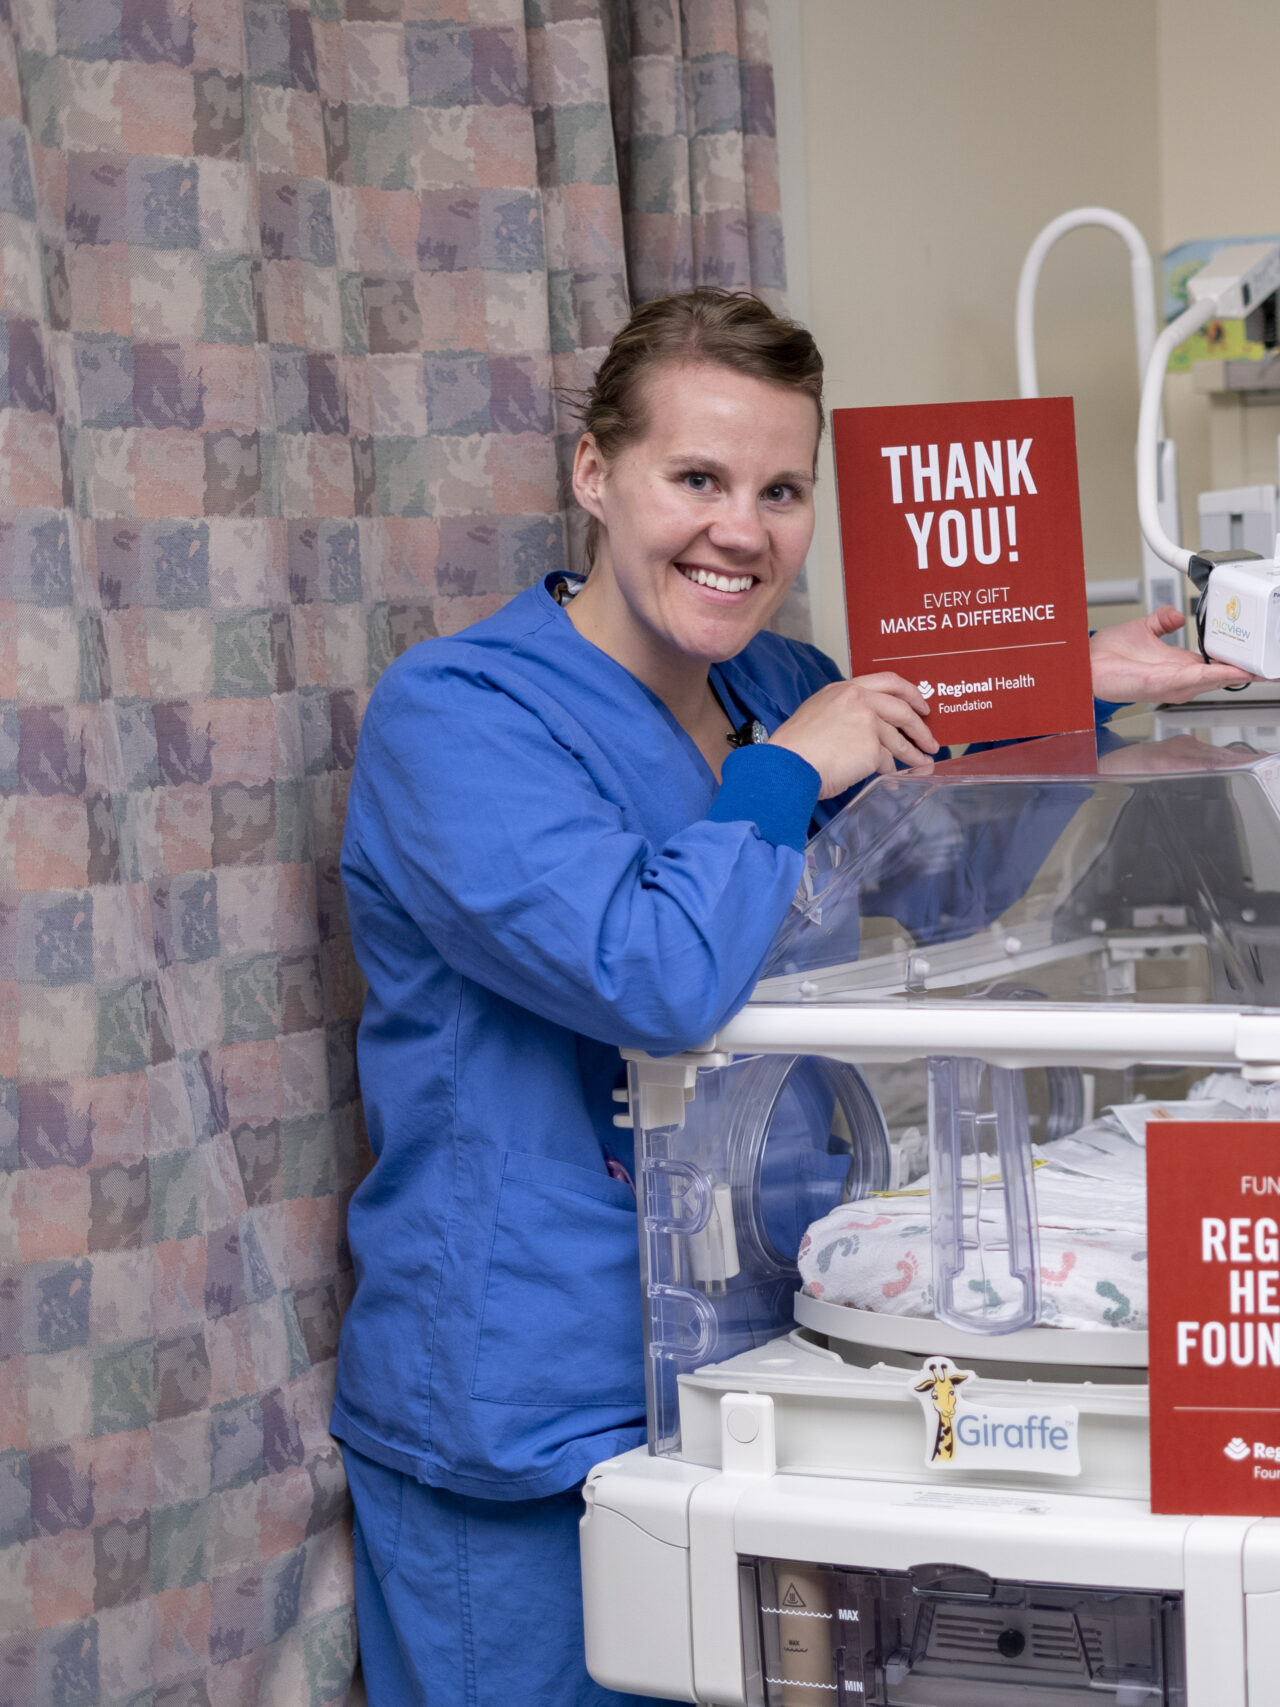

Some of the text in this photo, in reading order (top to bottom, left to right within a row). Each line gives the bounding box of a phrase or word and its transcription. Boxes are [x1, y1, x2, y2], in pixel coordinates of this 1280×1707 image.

[880, 438, 1038, 504] THANK
[904, 506, 1019, 570] YOU!
[923, 586, 1011, 610] EVERY GIFT
[880, 604, 1056, 635] MAKES A DIFFERENCE
[1211, 618, 1251, 639] nicview
[937, 674, 1035, 697] Regional Health
[938, 699, 993, 714] Foundation
[838, 1608, 860, 1621] MAX
[788, 1639, 801, 1647] MAX
[844, 1680, 864, 1692] MIN
